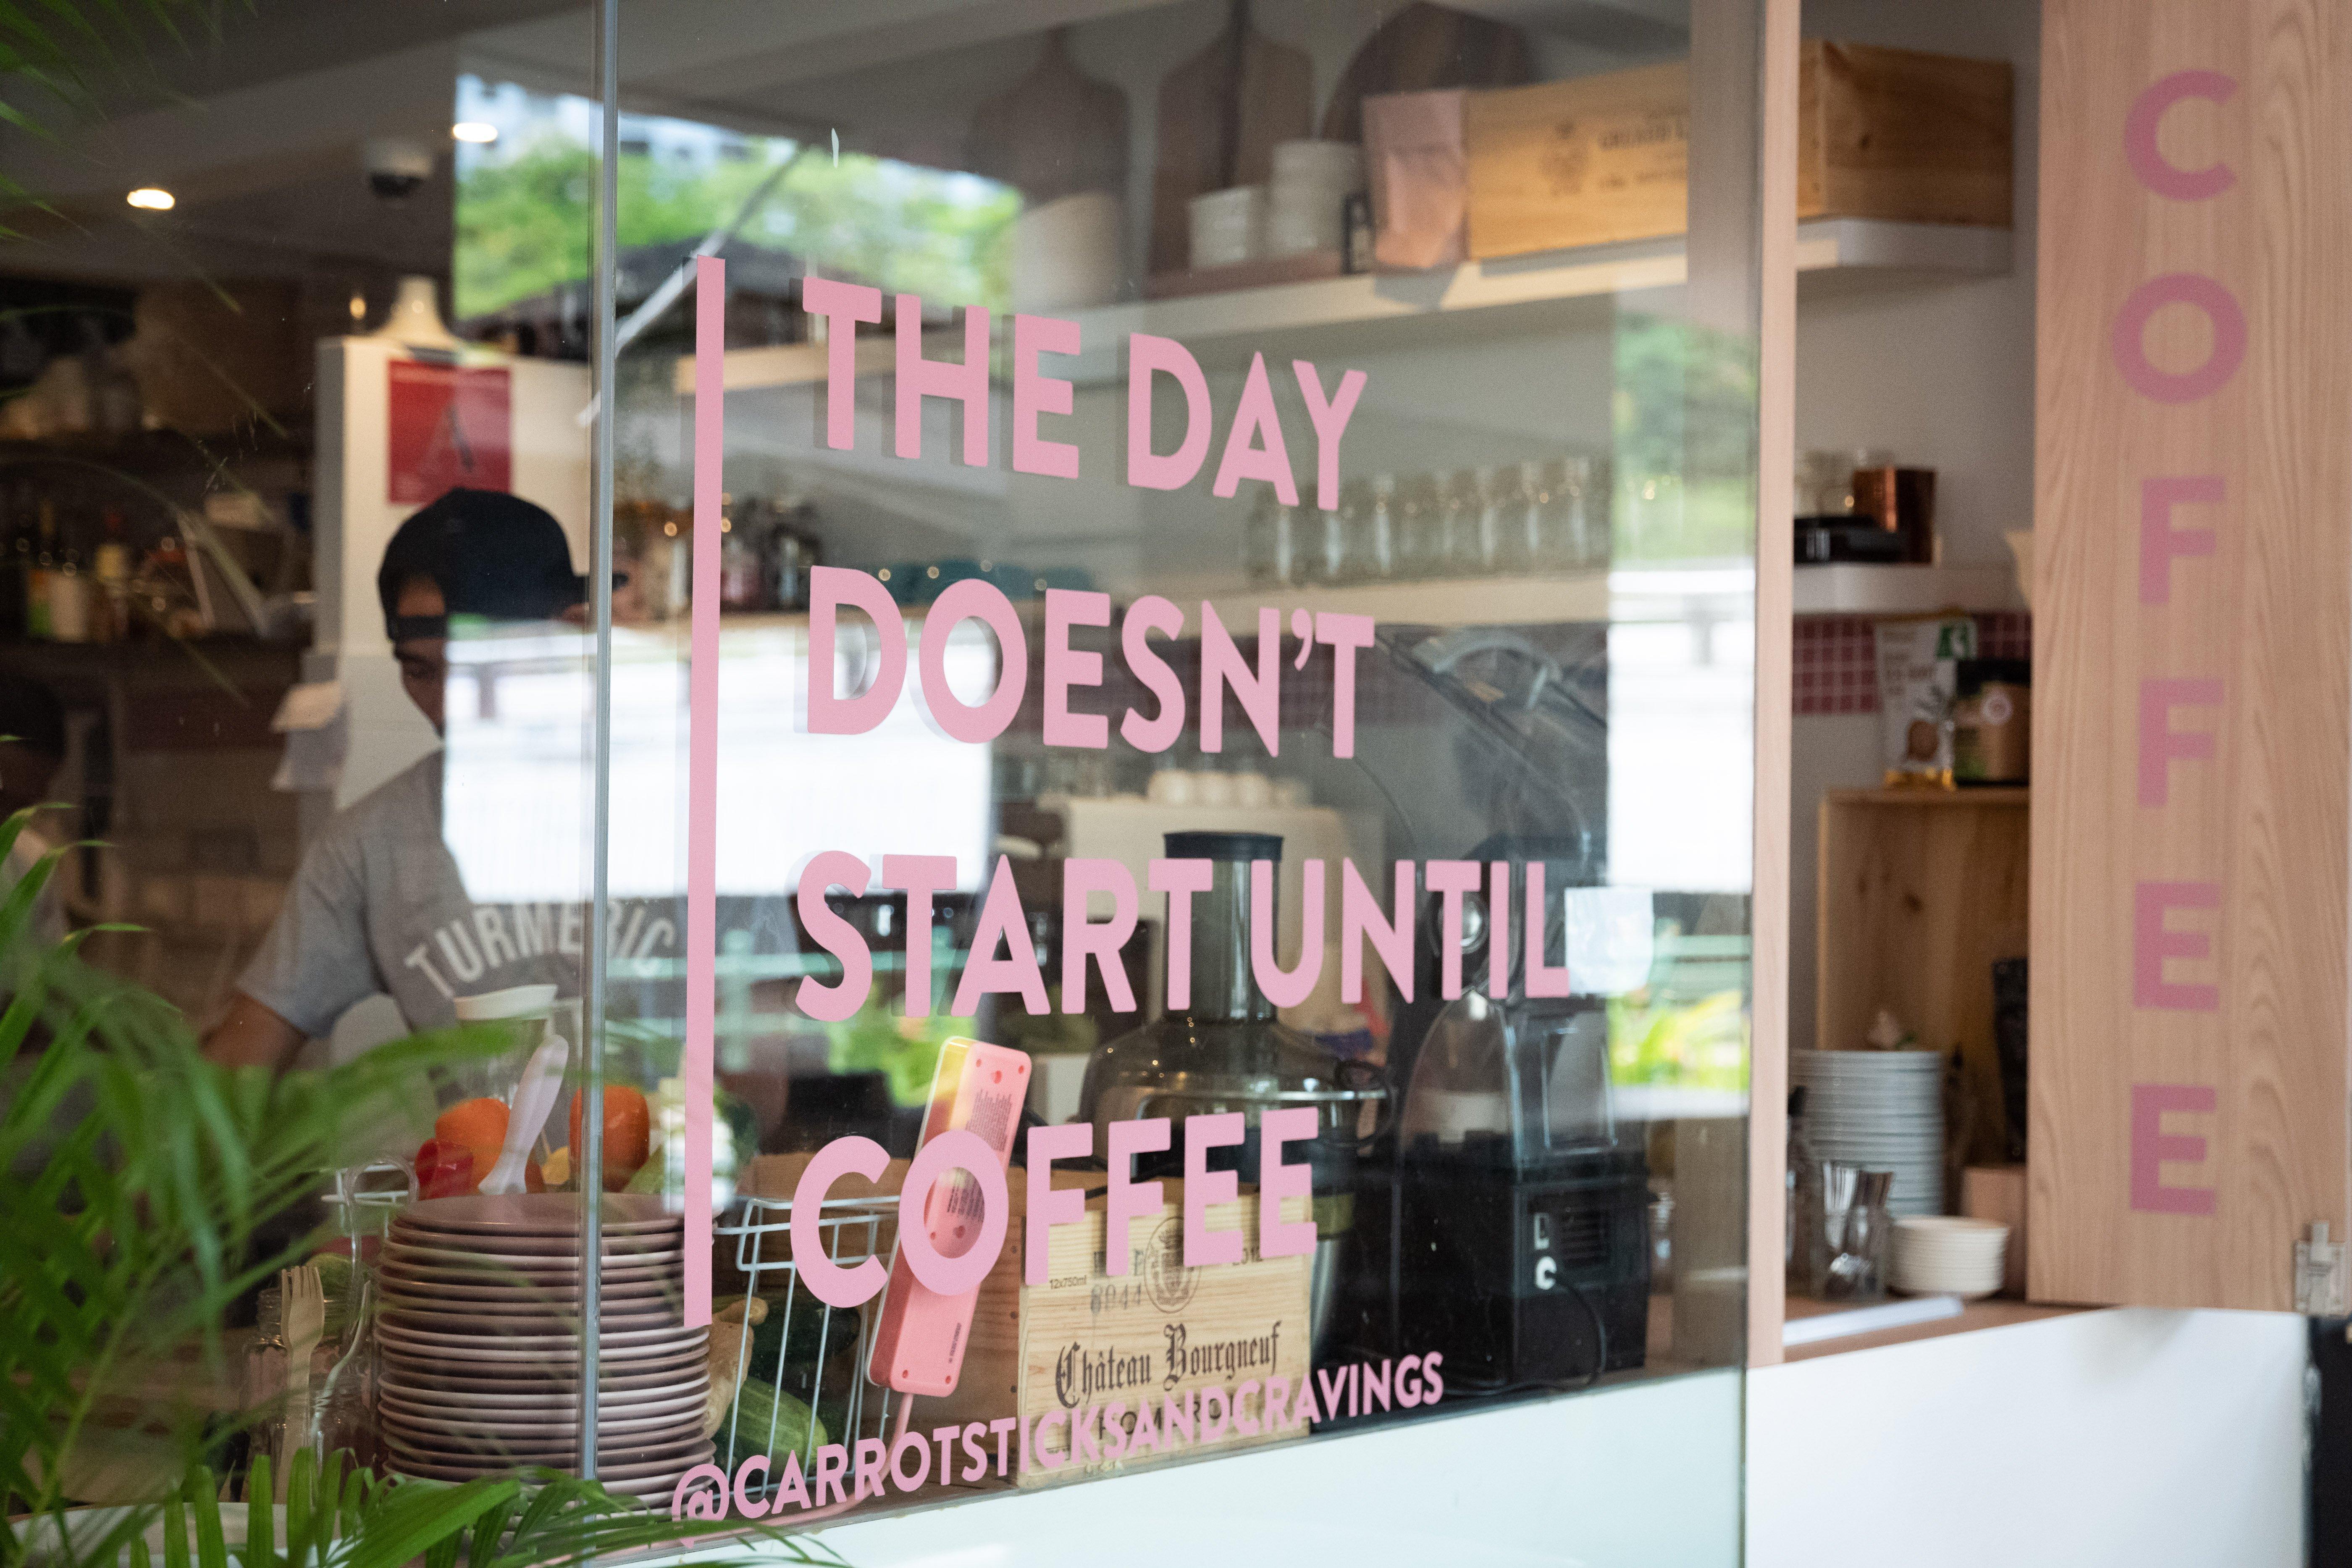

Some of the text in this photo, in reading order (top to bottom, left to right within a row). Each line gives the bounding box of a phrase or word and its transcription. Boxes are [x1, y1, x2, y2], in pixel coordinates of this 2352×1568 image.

[803, 276, 1367, 510] THE DAY
[2113, 69, 2248, 1215] COFFEE
[795, 850, 1570, 1022] START UNTIL
[790, 1107, 1318, 1308] COFFEE
[672, 1351, 1444, 1549] @CARROTSTICKSANDCRAVINGS
[1055, 1320, 1282, 1409] Château Bourgneuf
